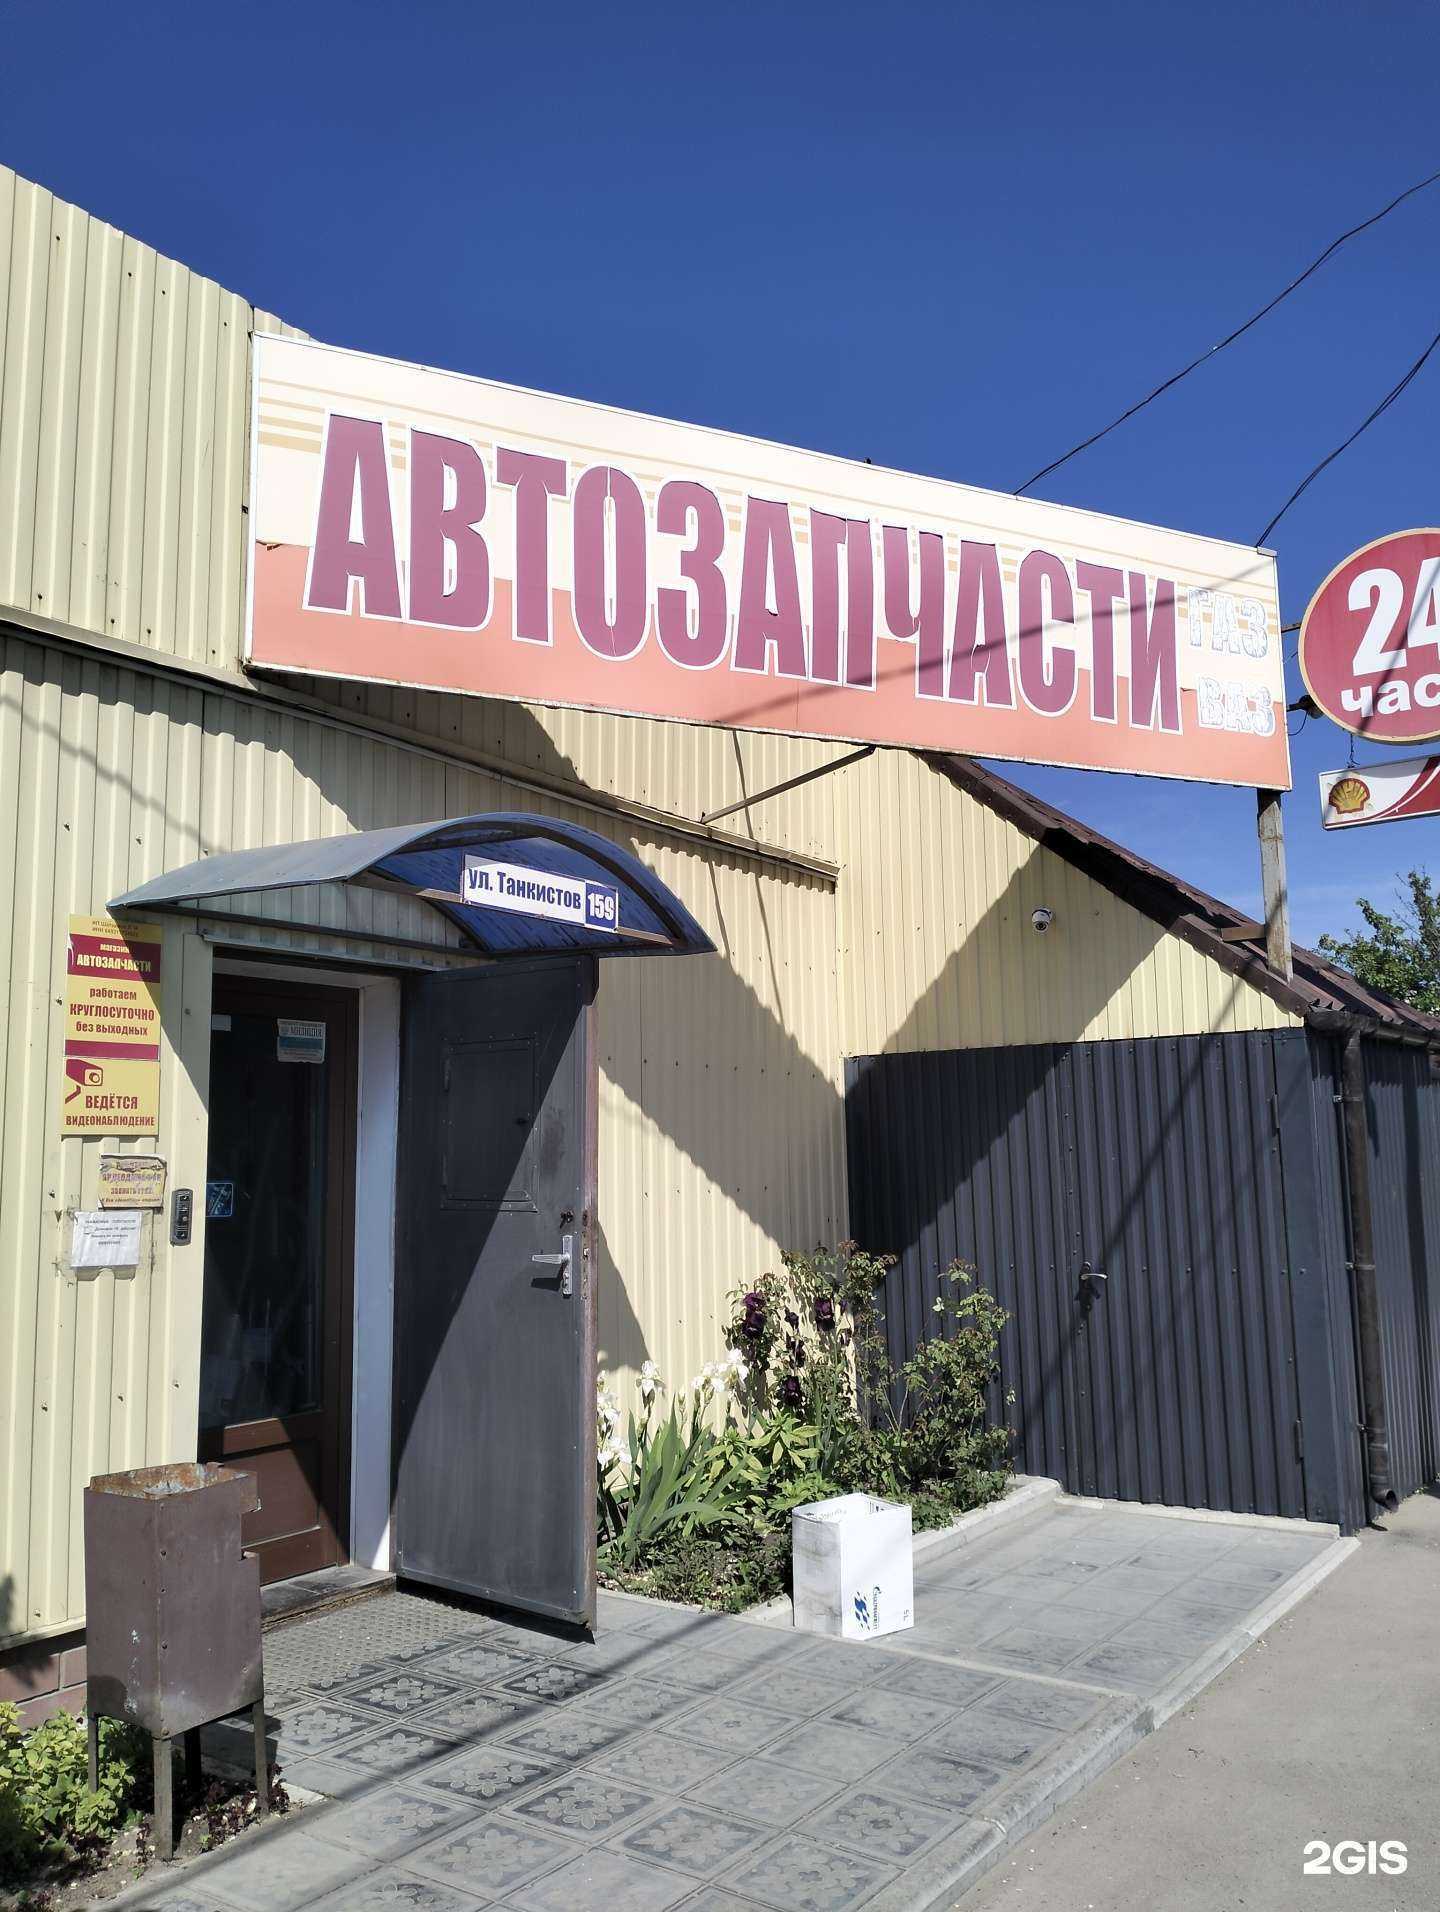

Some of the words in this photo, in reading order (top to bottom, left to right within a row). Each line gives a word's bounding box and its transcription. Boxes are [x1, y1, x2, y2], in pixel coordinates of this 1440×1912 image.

[302, 409, 1183, 735] АВТОЗАПЧАСТИ
[1186, 587, 1269, 659] ГАЗ
[1196, 673, 1276, 737] ВАЗ
[467, 868, 493, 891] ул.
[496, 871, 582, 910] Танкистов
[587, 892, 615, 921] 159
[77, 954, 152, 973] АВТОЗАПЧАСТИ
[89, 987, 137, 1000] работаем
[70, 1003, 155, 1021] КРУГЛОСУТОЧНО
[76, 1021, 94, 1033] без
[96, 1023, 149, 1036] выходных
[85, 1093, 138, 1111] ВЕДЁТСЯ
[65, 1115, 155, 1128] ВИДЕОНАБЛЮДЕНИЕ
